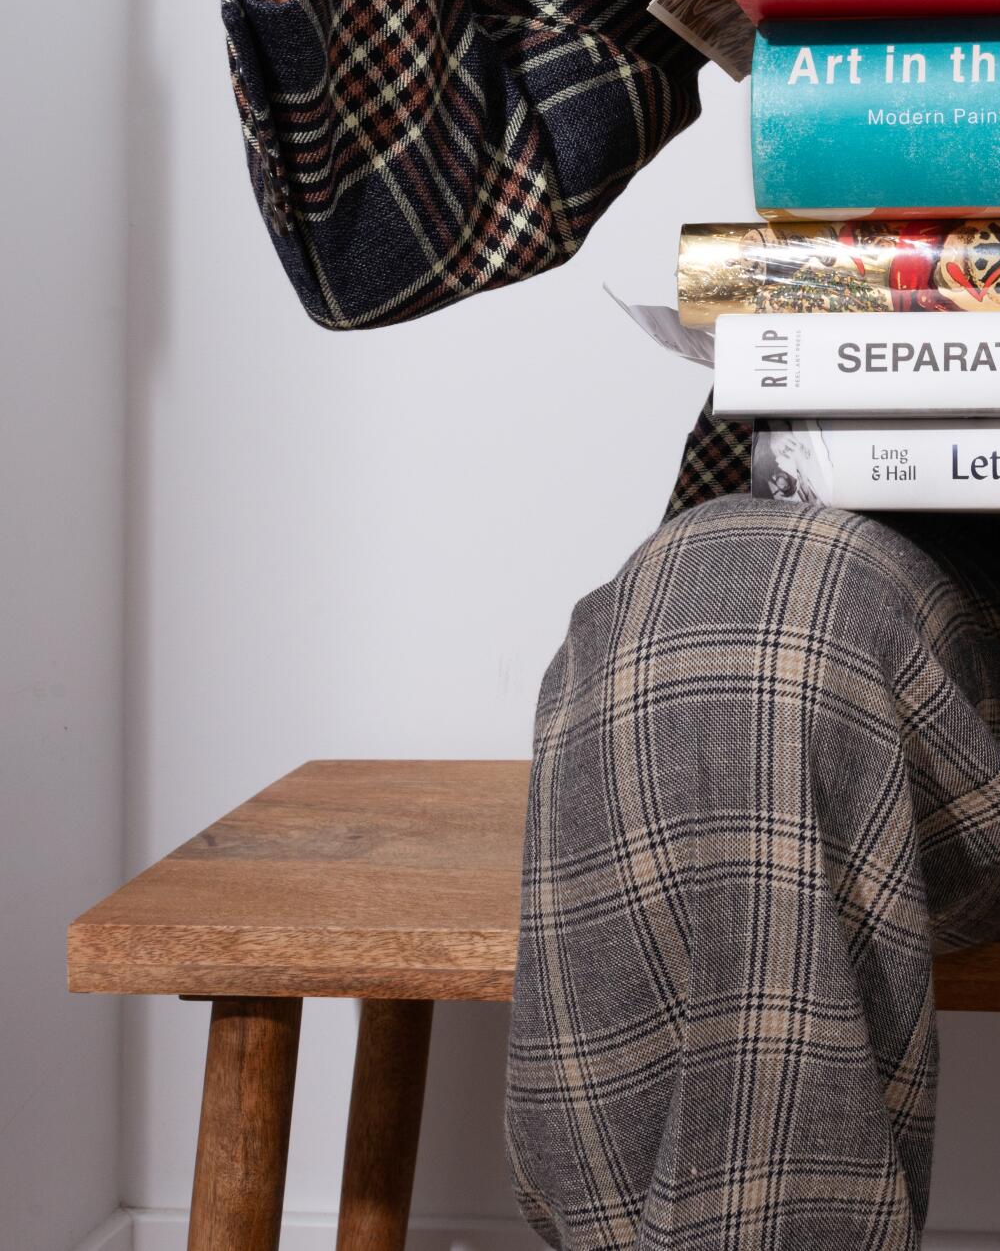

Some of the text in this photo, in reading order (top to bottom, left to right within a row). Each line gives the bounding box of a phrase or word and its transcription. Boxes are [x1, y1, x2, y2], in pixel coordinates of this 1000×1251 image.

[786, 47, 862, 85] Art
[885, 45, 926, 84] in
[868, 109, 944, 125] Modern
[872, 444, 908, 465] Lang
[871, 464, 917, 481] & Hall
